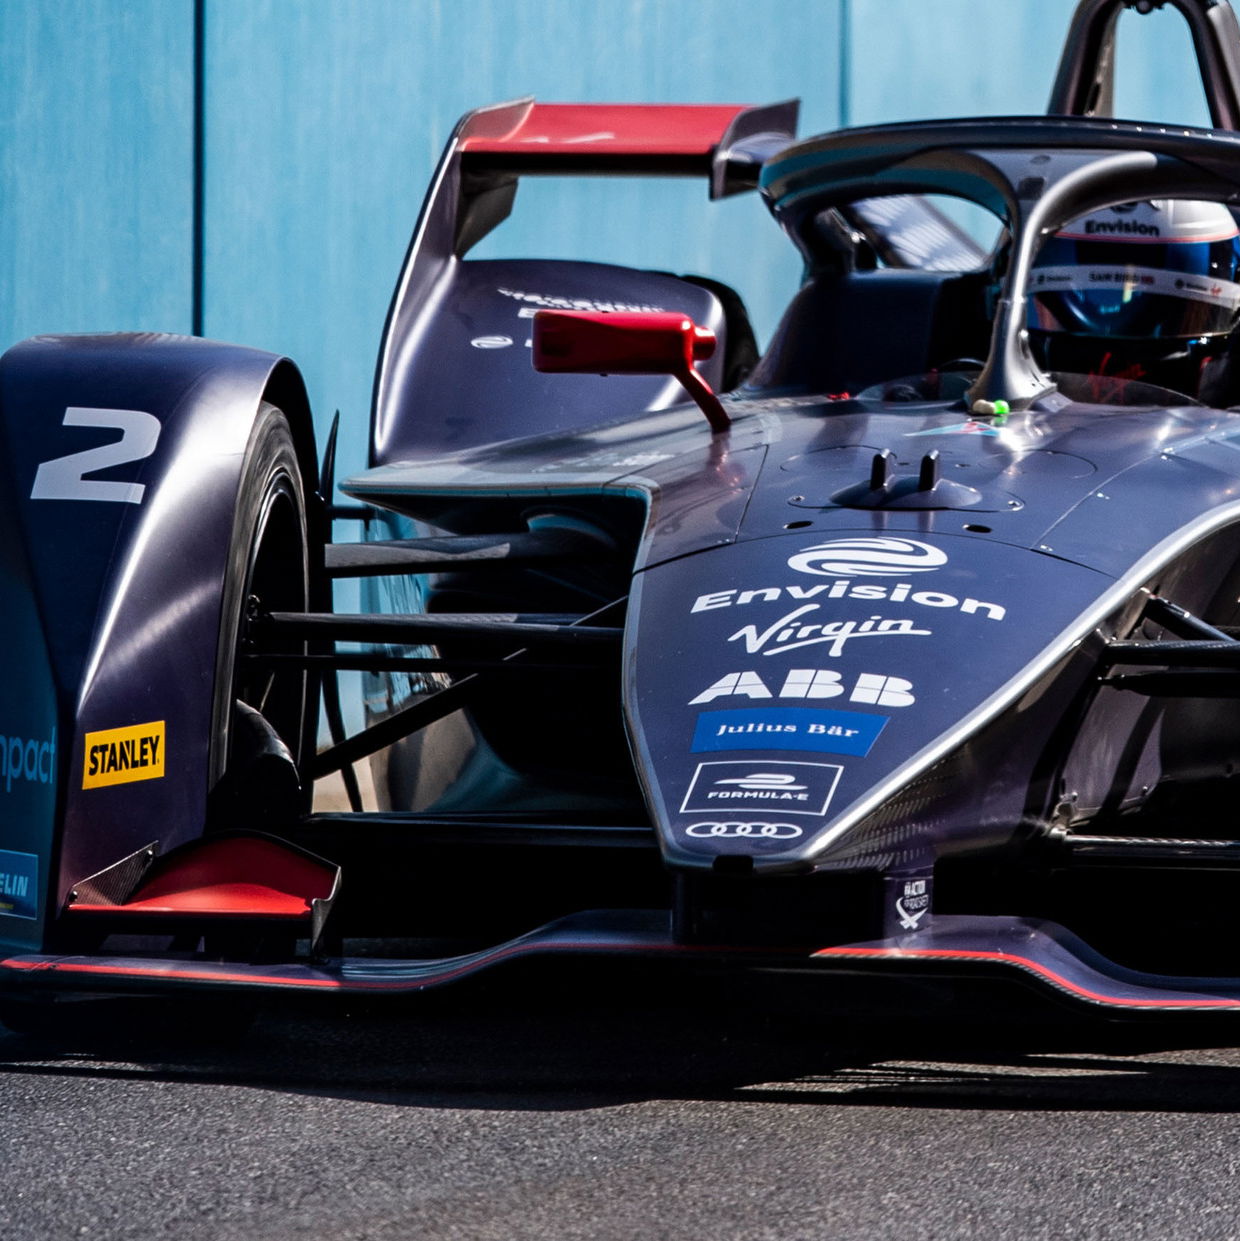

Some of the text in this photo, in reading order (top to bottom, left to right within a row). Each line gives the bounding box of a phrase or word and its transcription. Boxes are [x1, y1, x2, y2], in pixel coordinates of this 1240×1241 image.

[1084, 219, 1160, 237] Envision
[29, 406, 162, 505] 2
[689, 580, 1007, 621] Envision
[728, 603, 932, 657] Virgin
[687, 668, 916, 708] ABB
[716, 722, 860, 738] Julius Bär
[88, 735, 160, 777] STANLEY
